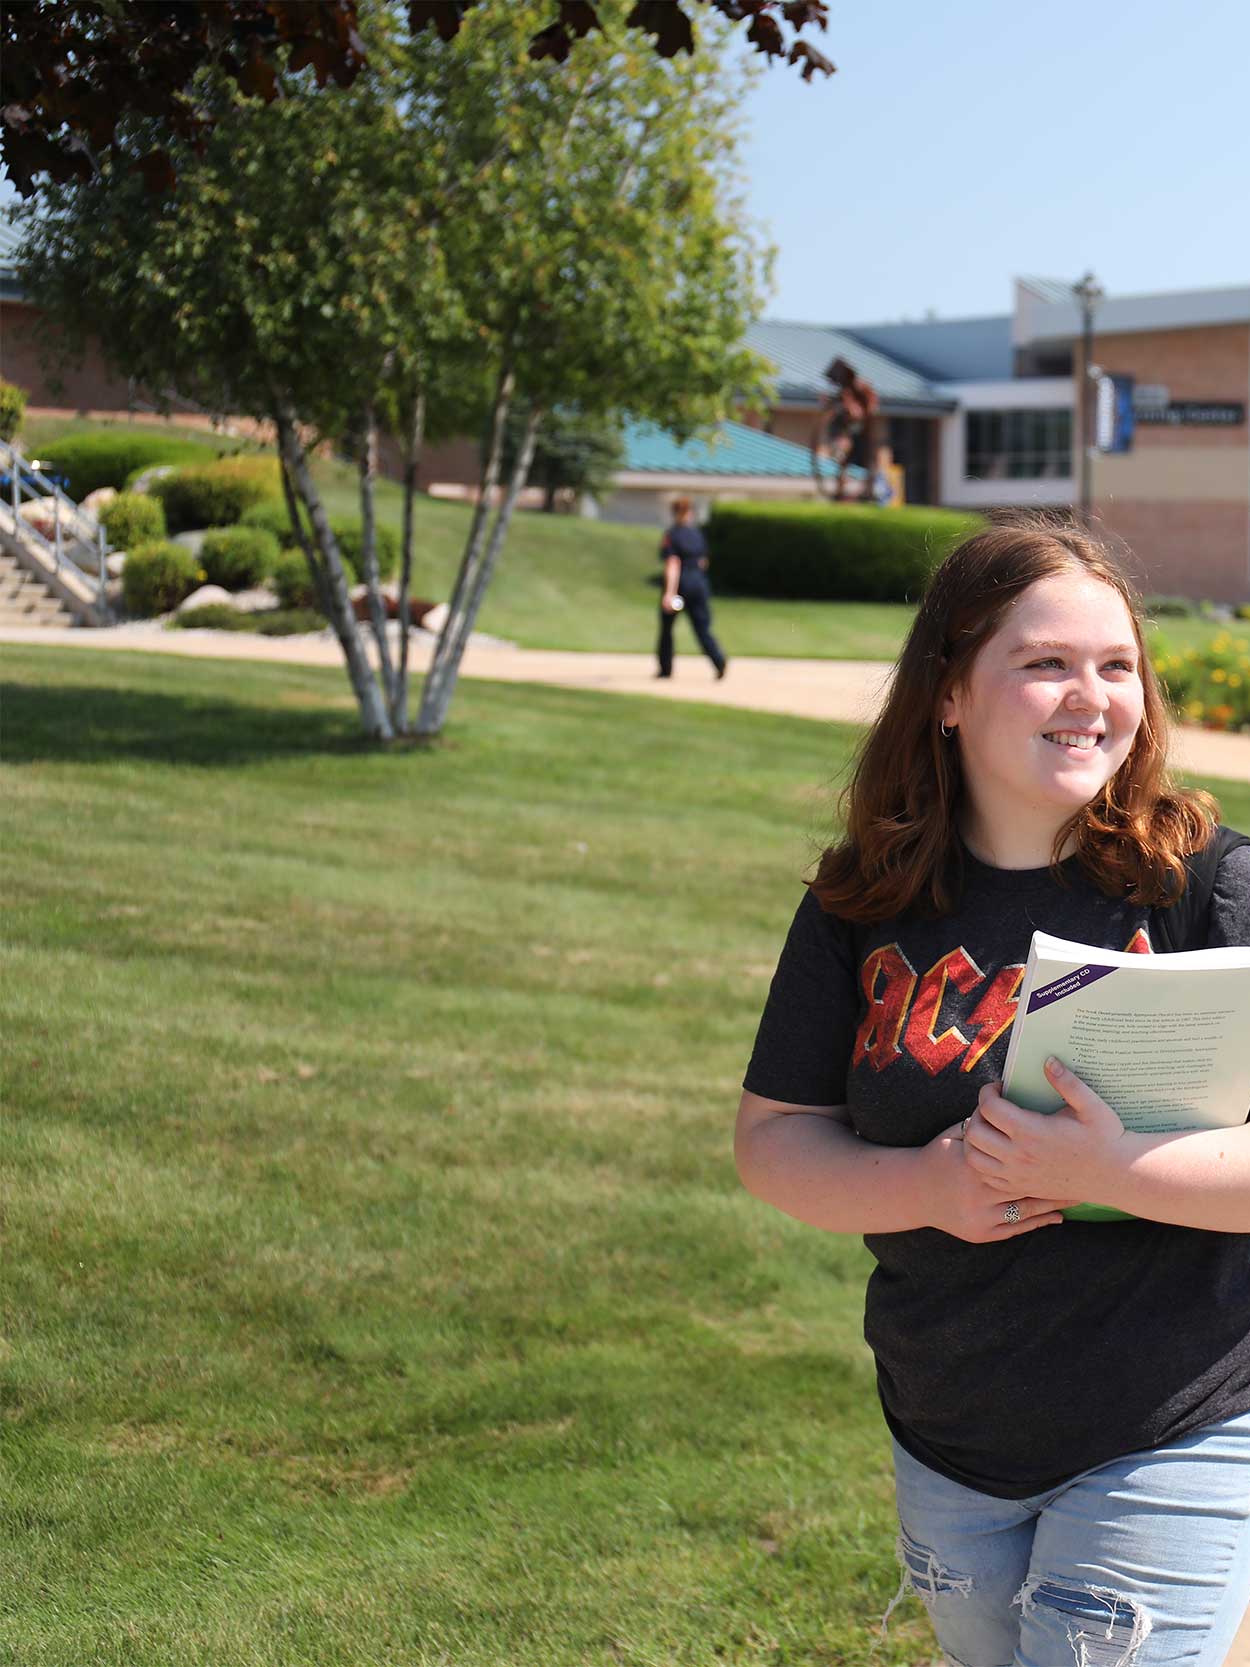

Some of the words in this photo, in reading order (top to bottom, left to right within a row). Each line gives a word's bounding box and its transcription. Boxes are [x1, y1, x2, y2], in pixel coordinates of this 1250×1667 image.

[1036, 974, 1080, 998] Supplementary
[1079, 968, 1091, 977] CD
[1054, 981, 1081, 998] Included
